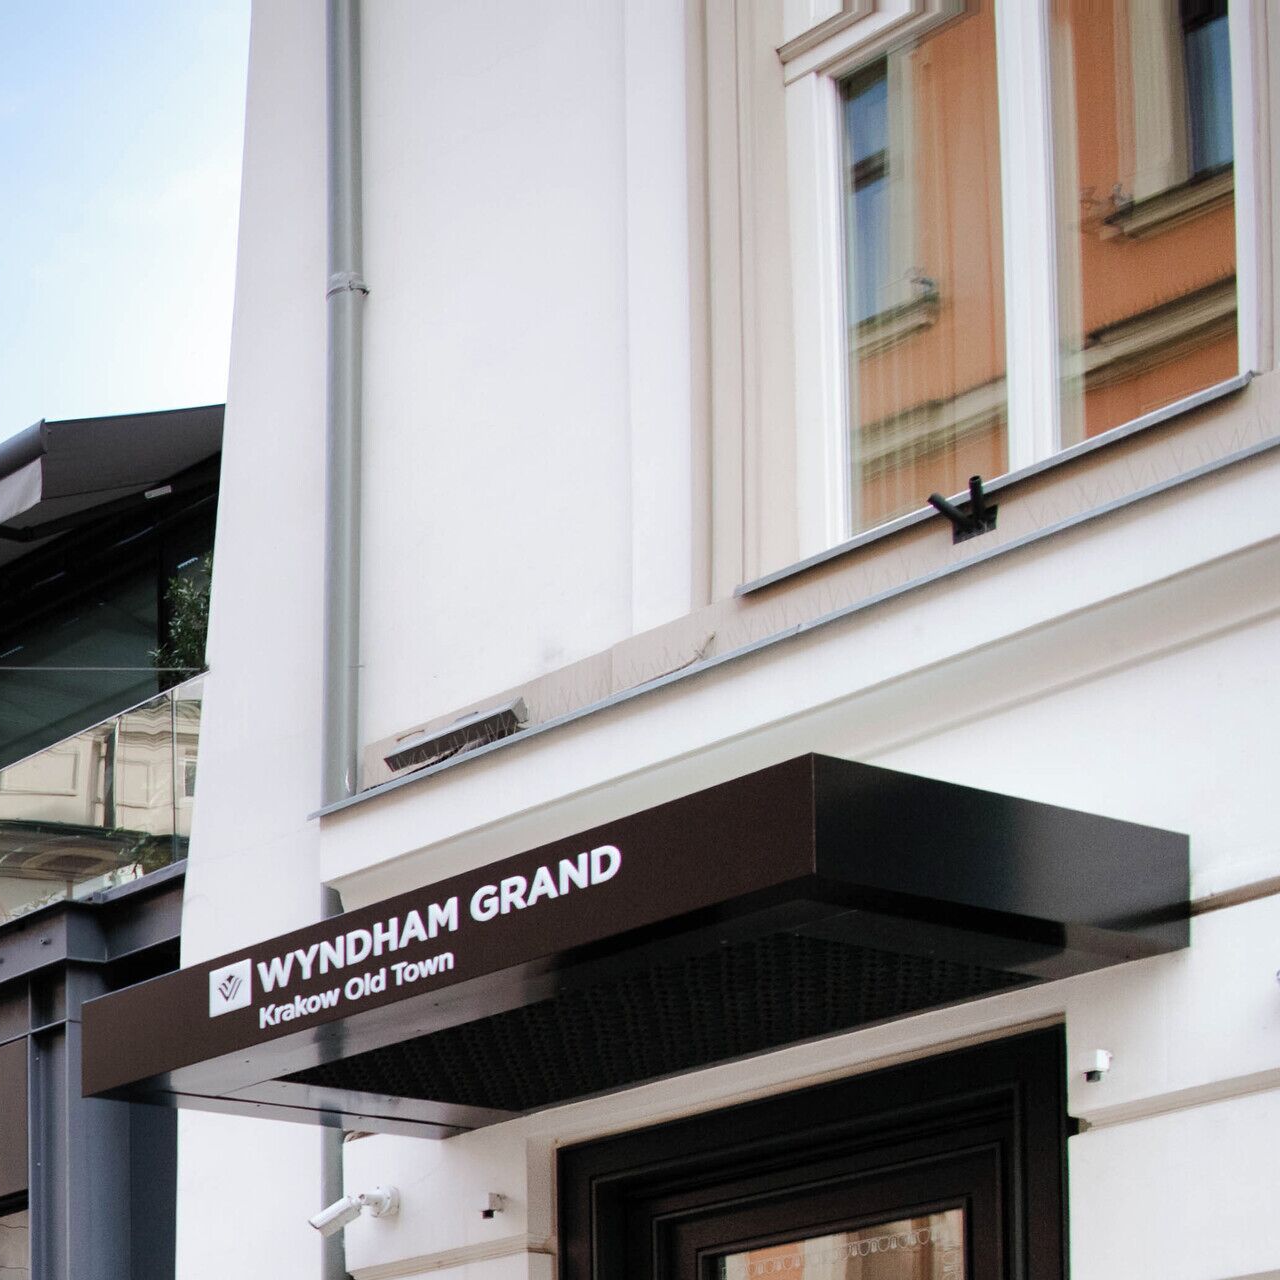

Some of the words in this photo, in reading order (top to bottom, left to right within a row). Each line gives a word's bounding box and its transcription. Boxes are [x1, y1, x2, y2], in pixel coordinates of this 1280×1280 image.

[256, 896, 459, 993] WYNDHAM
[469, 844, 622, 922] GRAND
[258, 986, 341, 1029] Krakow
[344, 967, 386, 1001] Old
[391, 952, 454, 987] Town
